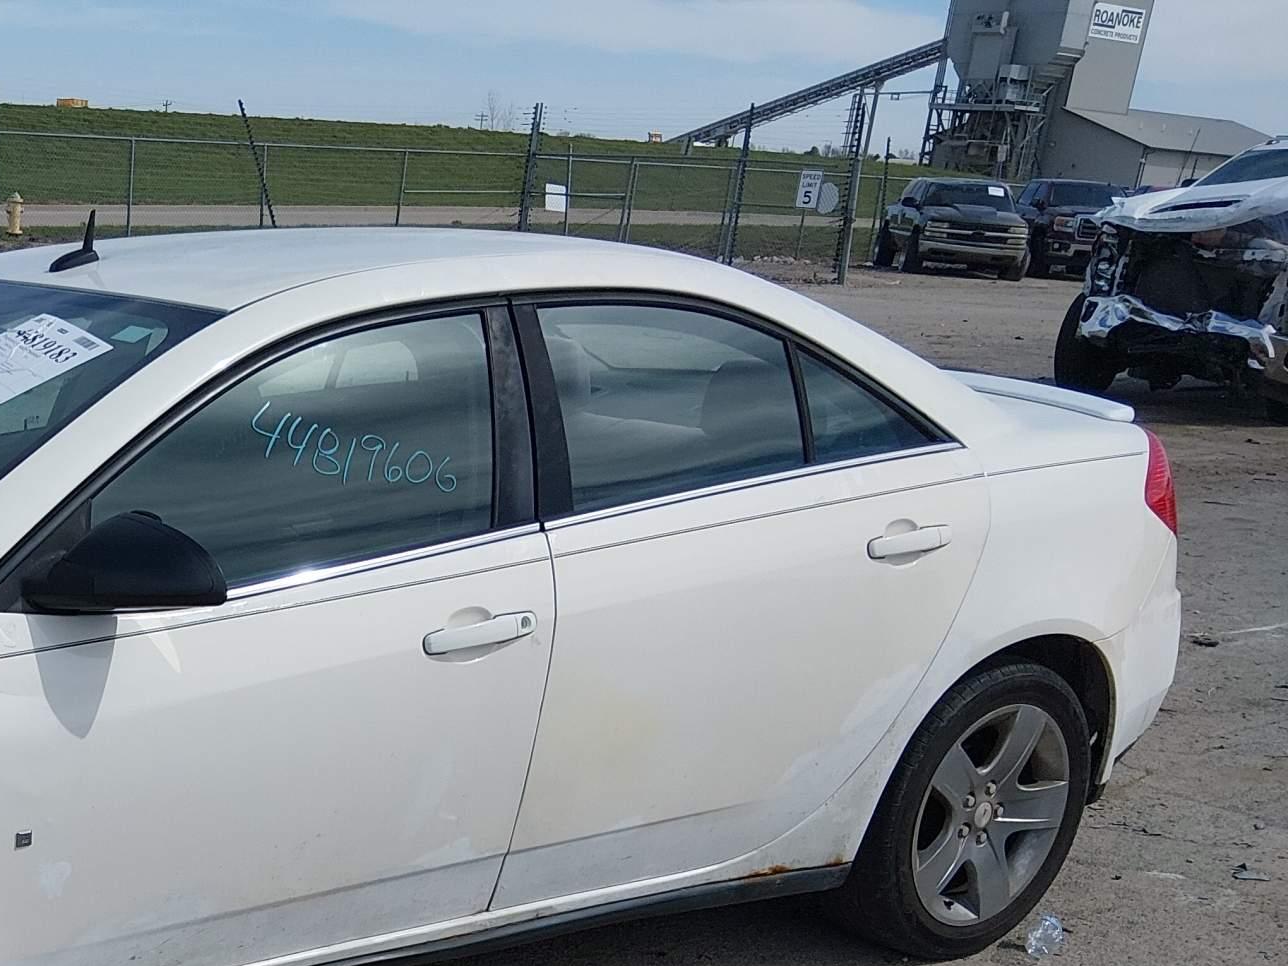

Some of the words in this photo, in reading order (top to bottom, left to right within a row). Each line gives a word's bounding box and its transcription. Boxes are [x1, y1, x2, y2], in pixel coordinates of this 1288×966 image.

[1094, 9, 1142, 29] ROANOKE
[802, 190, 812, 204] 5
[251, 401, 456, 491] 44819606
